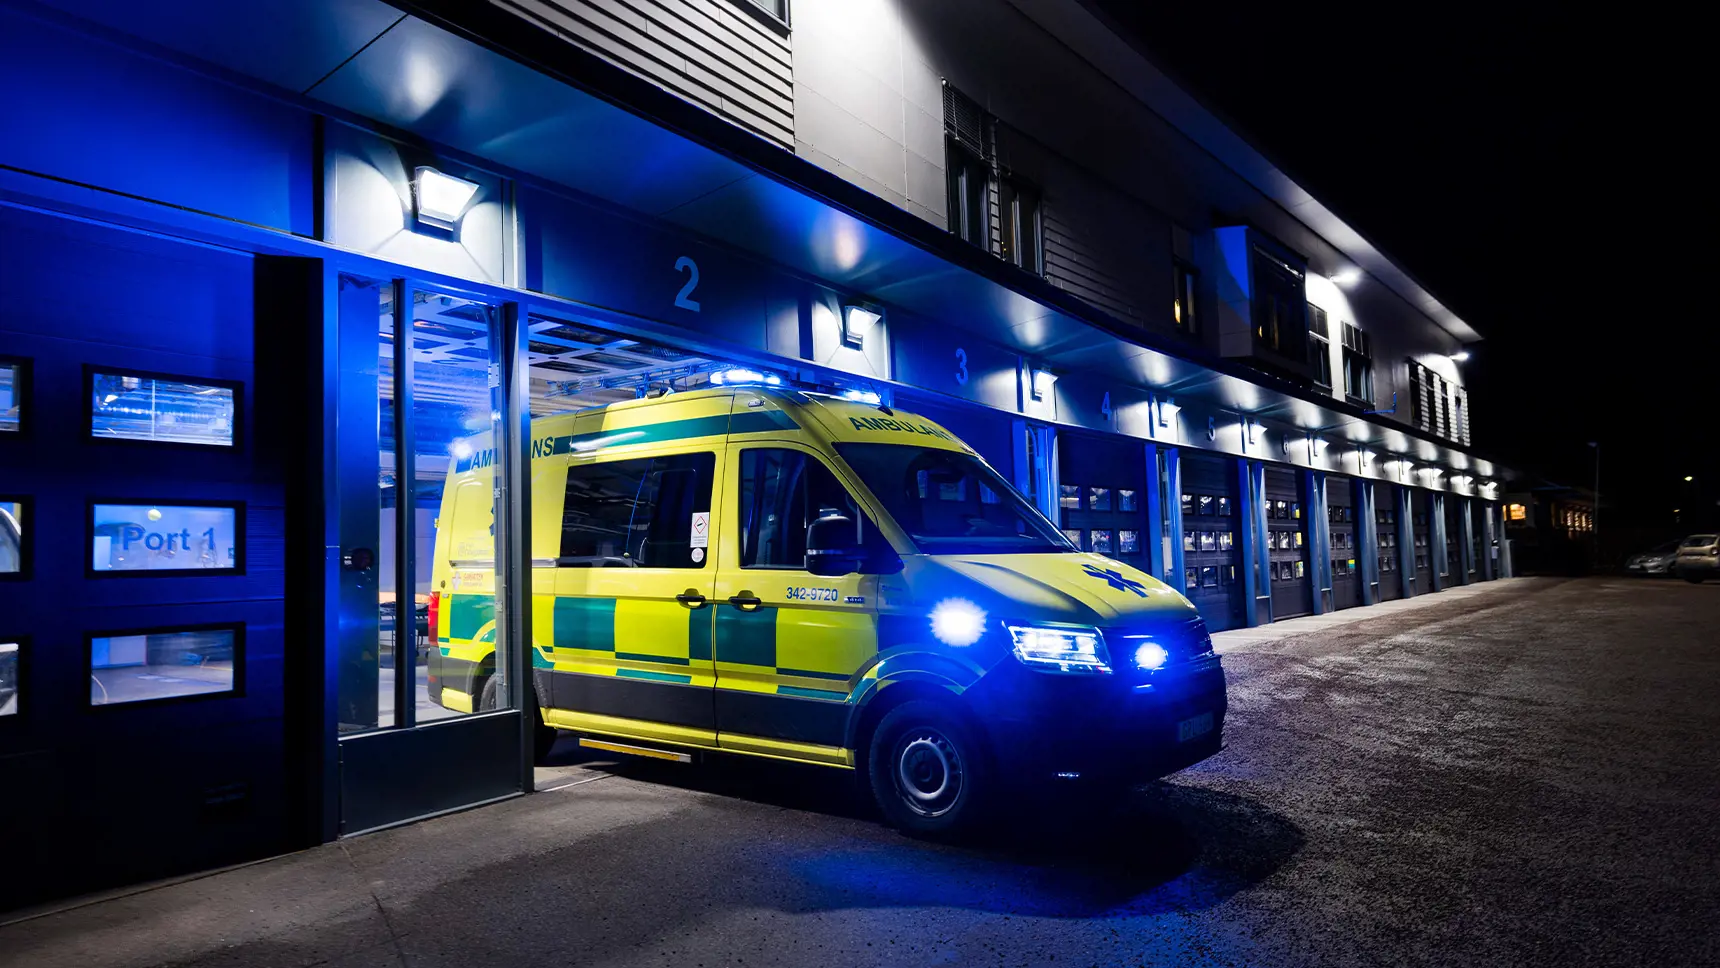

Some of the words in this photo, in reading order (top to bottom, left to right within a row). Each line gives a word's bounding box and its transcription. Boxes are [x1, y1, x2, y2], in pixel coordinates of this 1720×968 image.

[674, 256, 700, 312] 2
[955, 348, 968, 386] 3
[1101, 391, 1112, 420] 4
[848, 417, 956, 443] AMBULAN
[1208, 416, 1216, 441] 5
[123, 526, 190, 551] Port
[203, 527, 214, 550] 1
[786, 586, 838, 602] 342-9720
